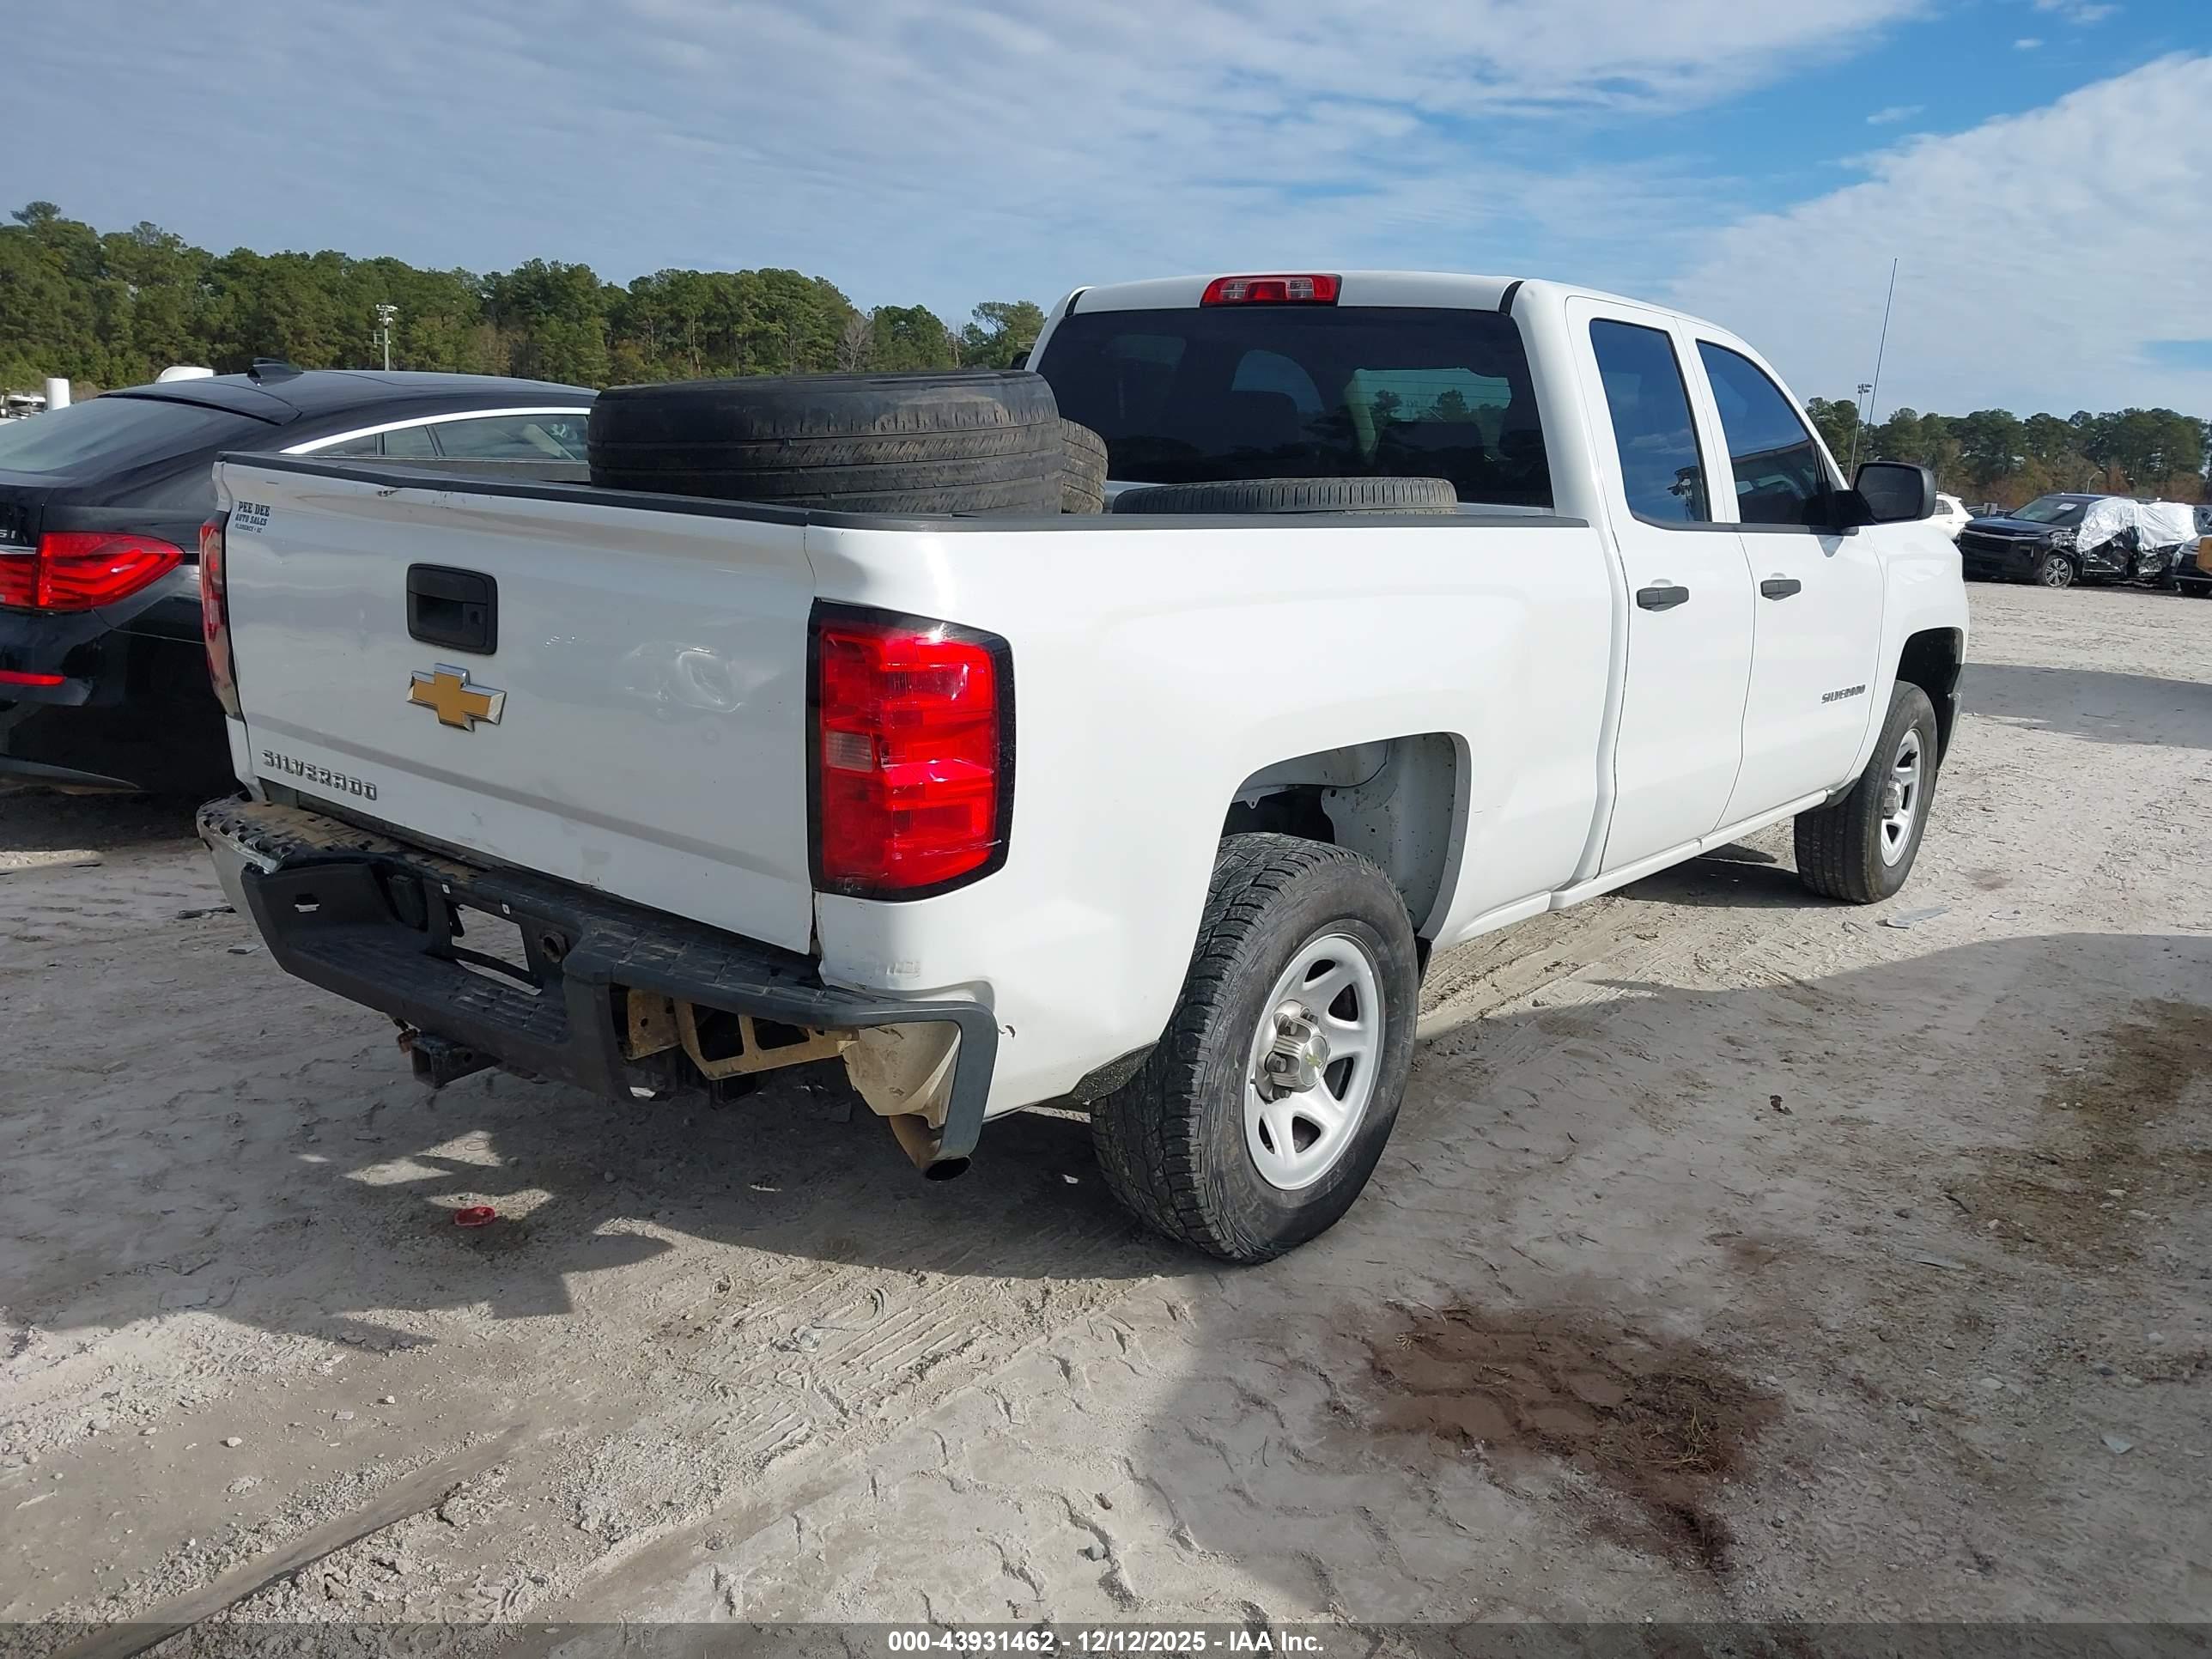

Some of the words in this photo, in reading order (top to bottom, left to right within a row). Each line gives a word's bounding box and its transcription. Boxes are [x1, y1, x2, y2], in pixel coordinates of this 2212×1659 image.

[238, 501, 253, 514] PEE
[254, 504, 270, 517] DEE
[235, 513, 250, 523] AUTO
[250, 516, 268, 526] SALES
[1820, 684, 1866, 704] SILVERADO
[262, 749, 377, 801] SILVERADO
